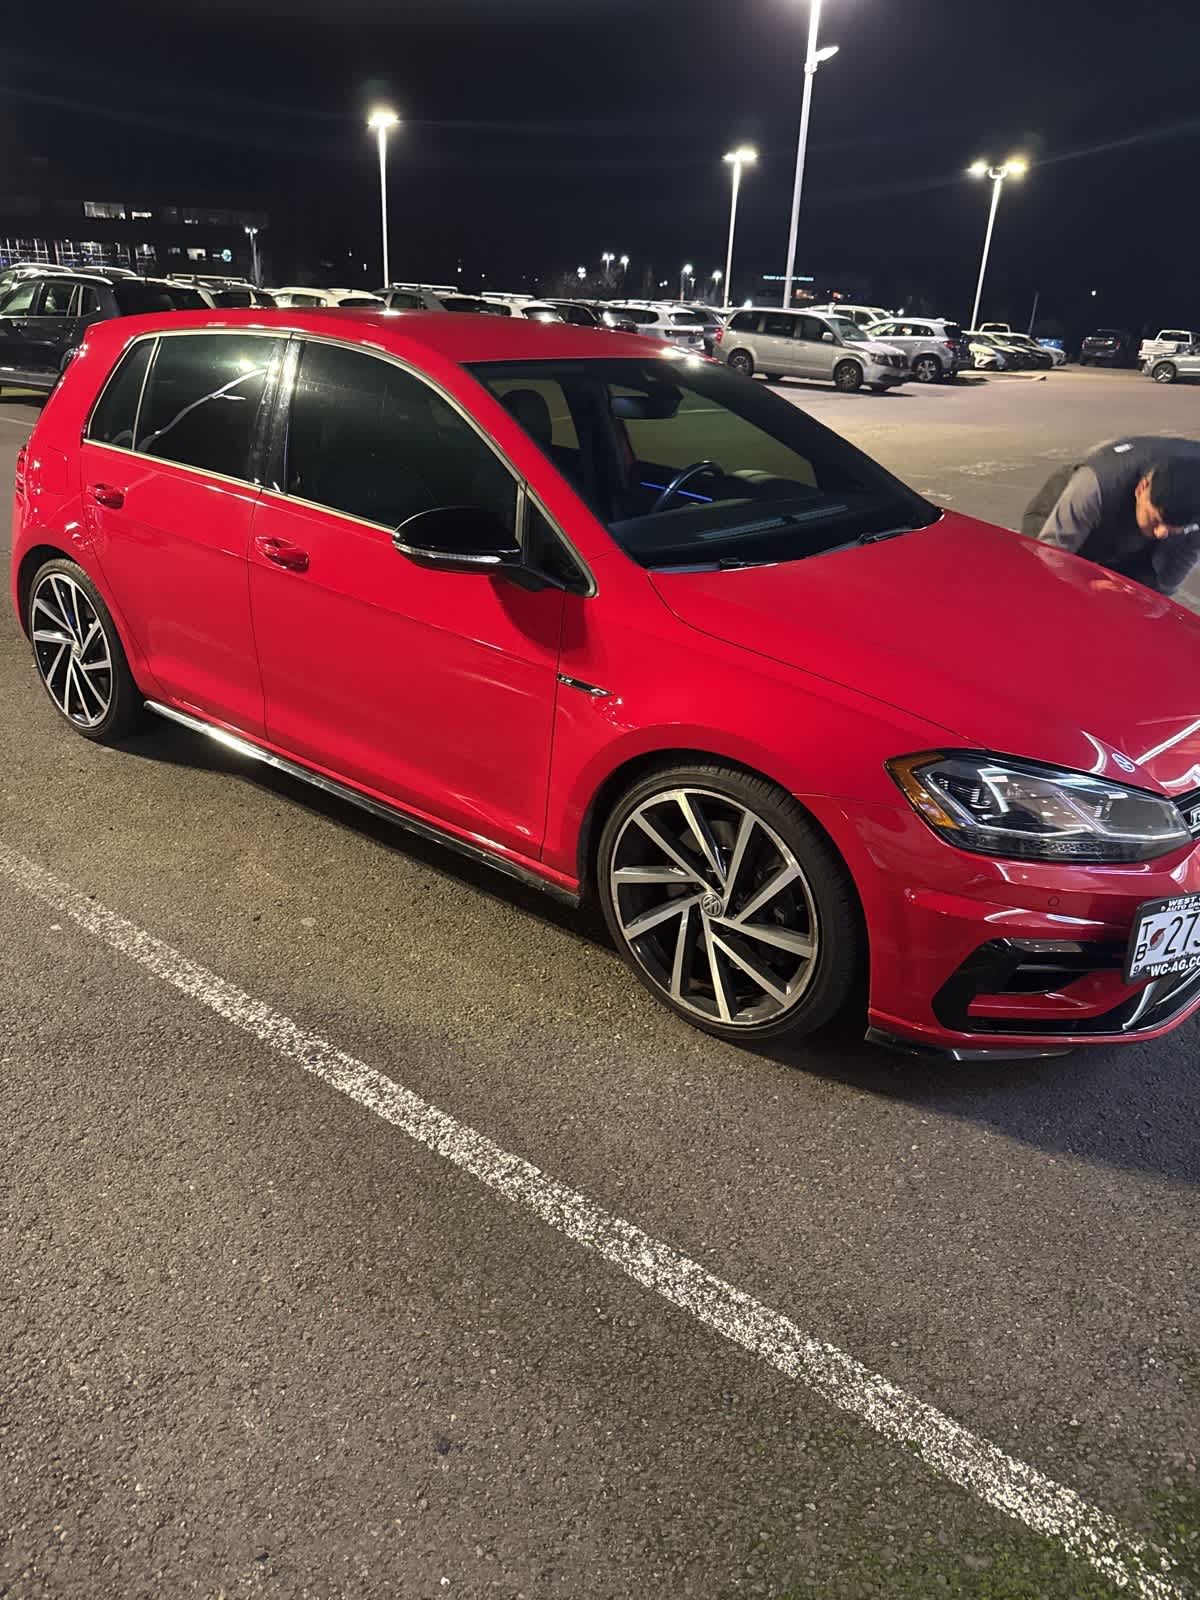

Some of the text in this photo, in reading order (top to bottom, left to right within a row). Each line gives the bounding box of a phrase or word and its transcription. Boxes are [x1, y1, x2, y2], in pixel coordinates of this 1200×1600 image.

[1168, 896, 1197, 907] WEST
[1166, 904, 1187, 912] AUTO
[1163, 912, 1200, 955] 27
